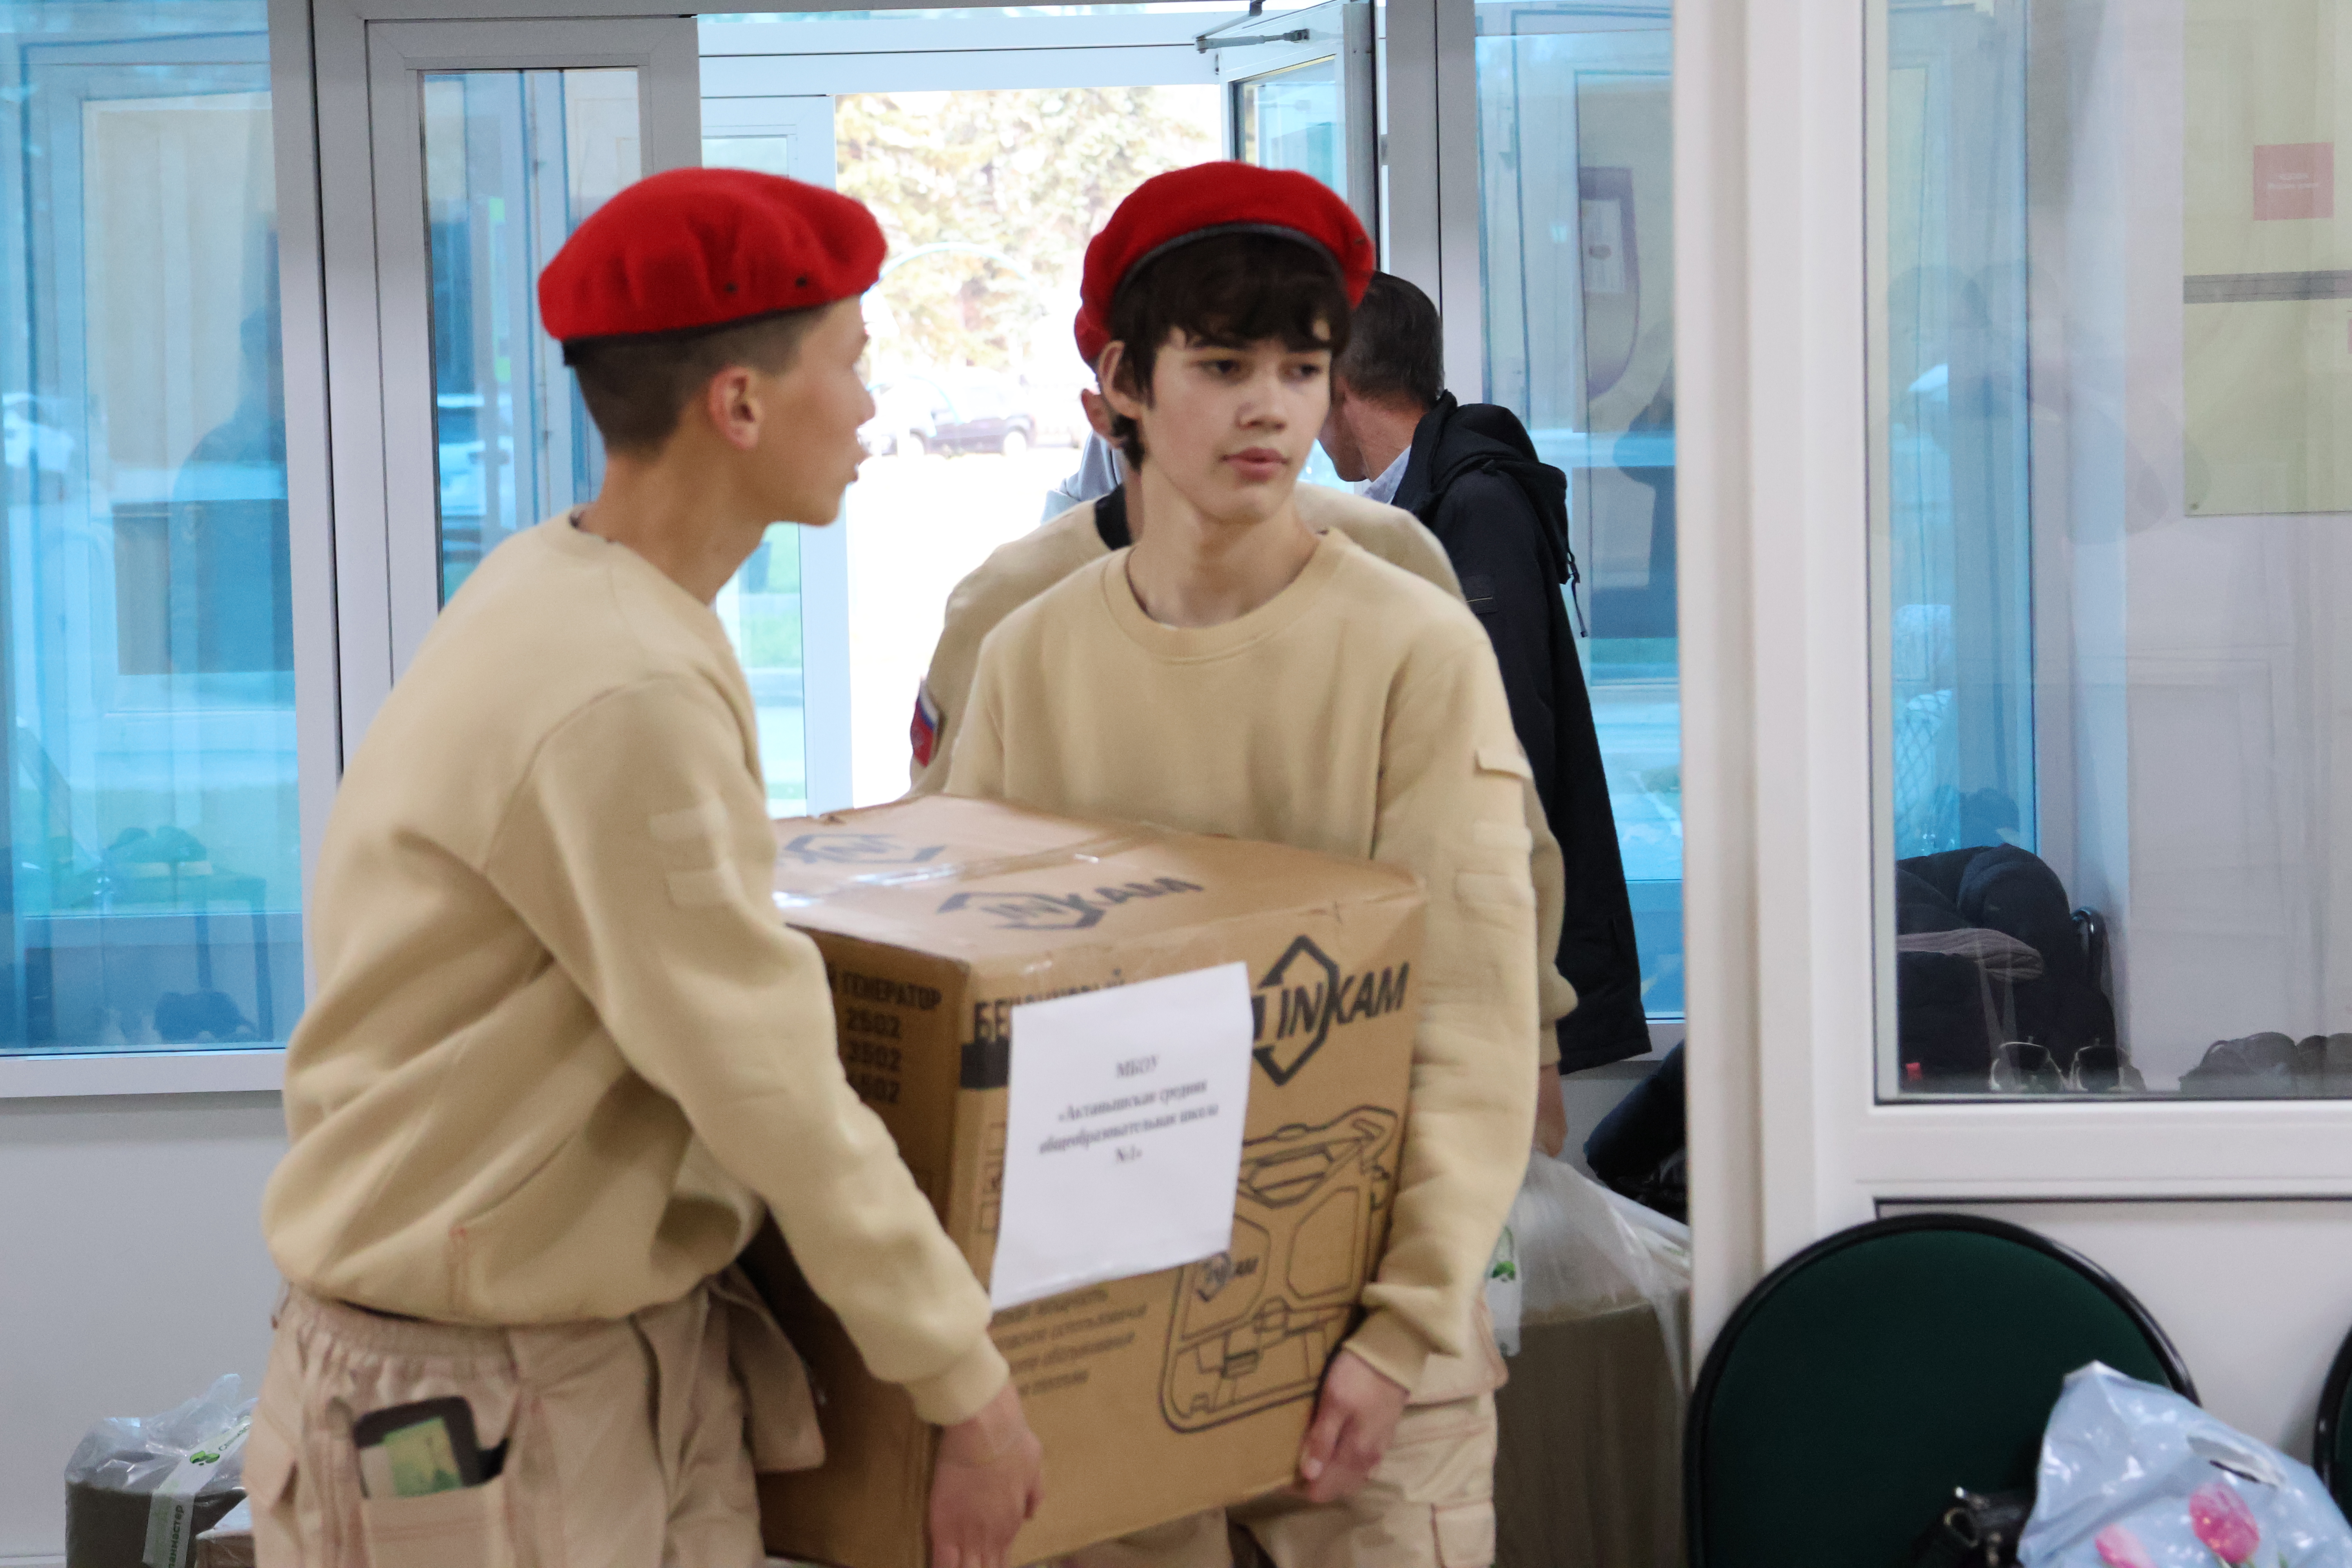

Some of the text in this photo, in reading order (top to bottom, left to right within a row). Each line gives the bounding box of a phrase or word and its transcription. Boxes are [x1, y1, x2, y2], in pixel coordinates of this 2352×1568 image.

[842, 970, 942, 1011] ГЕНЕРАТОР
[846, 1007, 902, 1039] 2502
[1116, 1055, 1158, 1078] МБОУ
